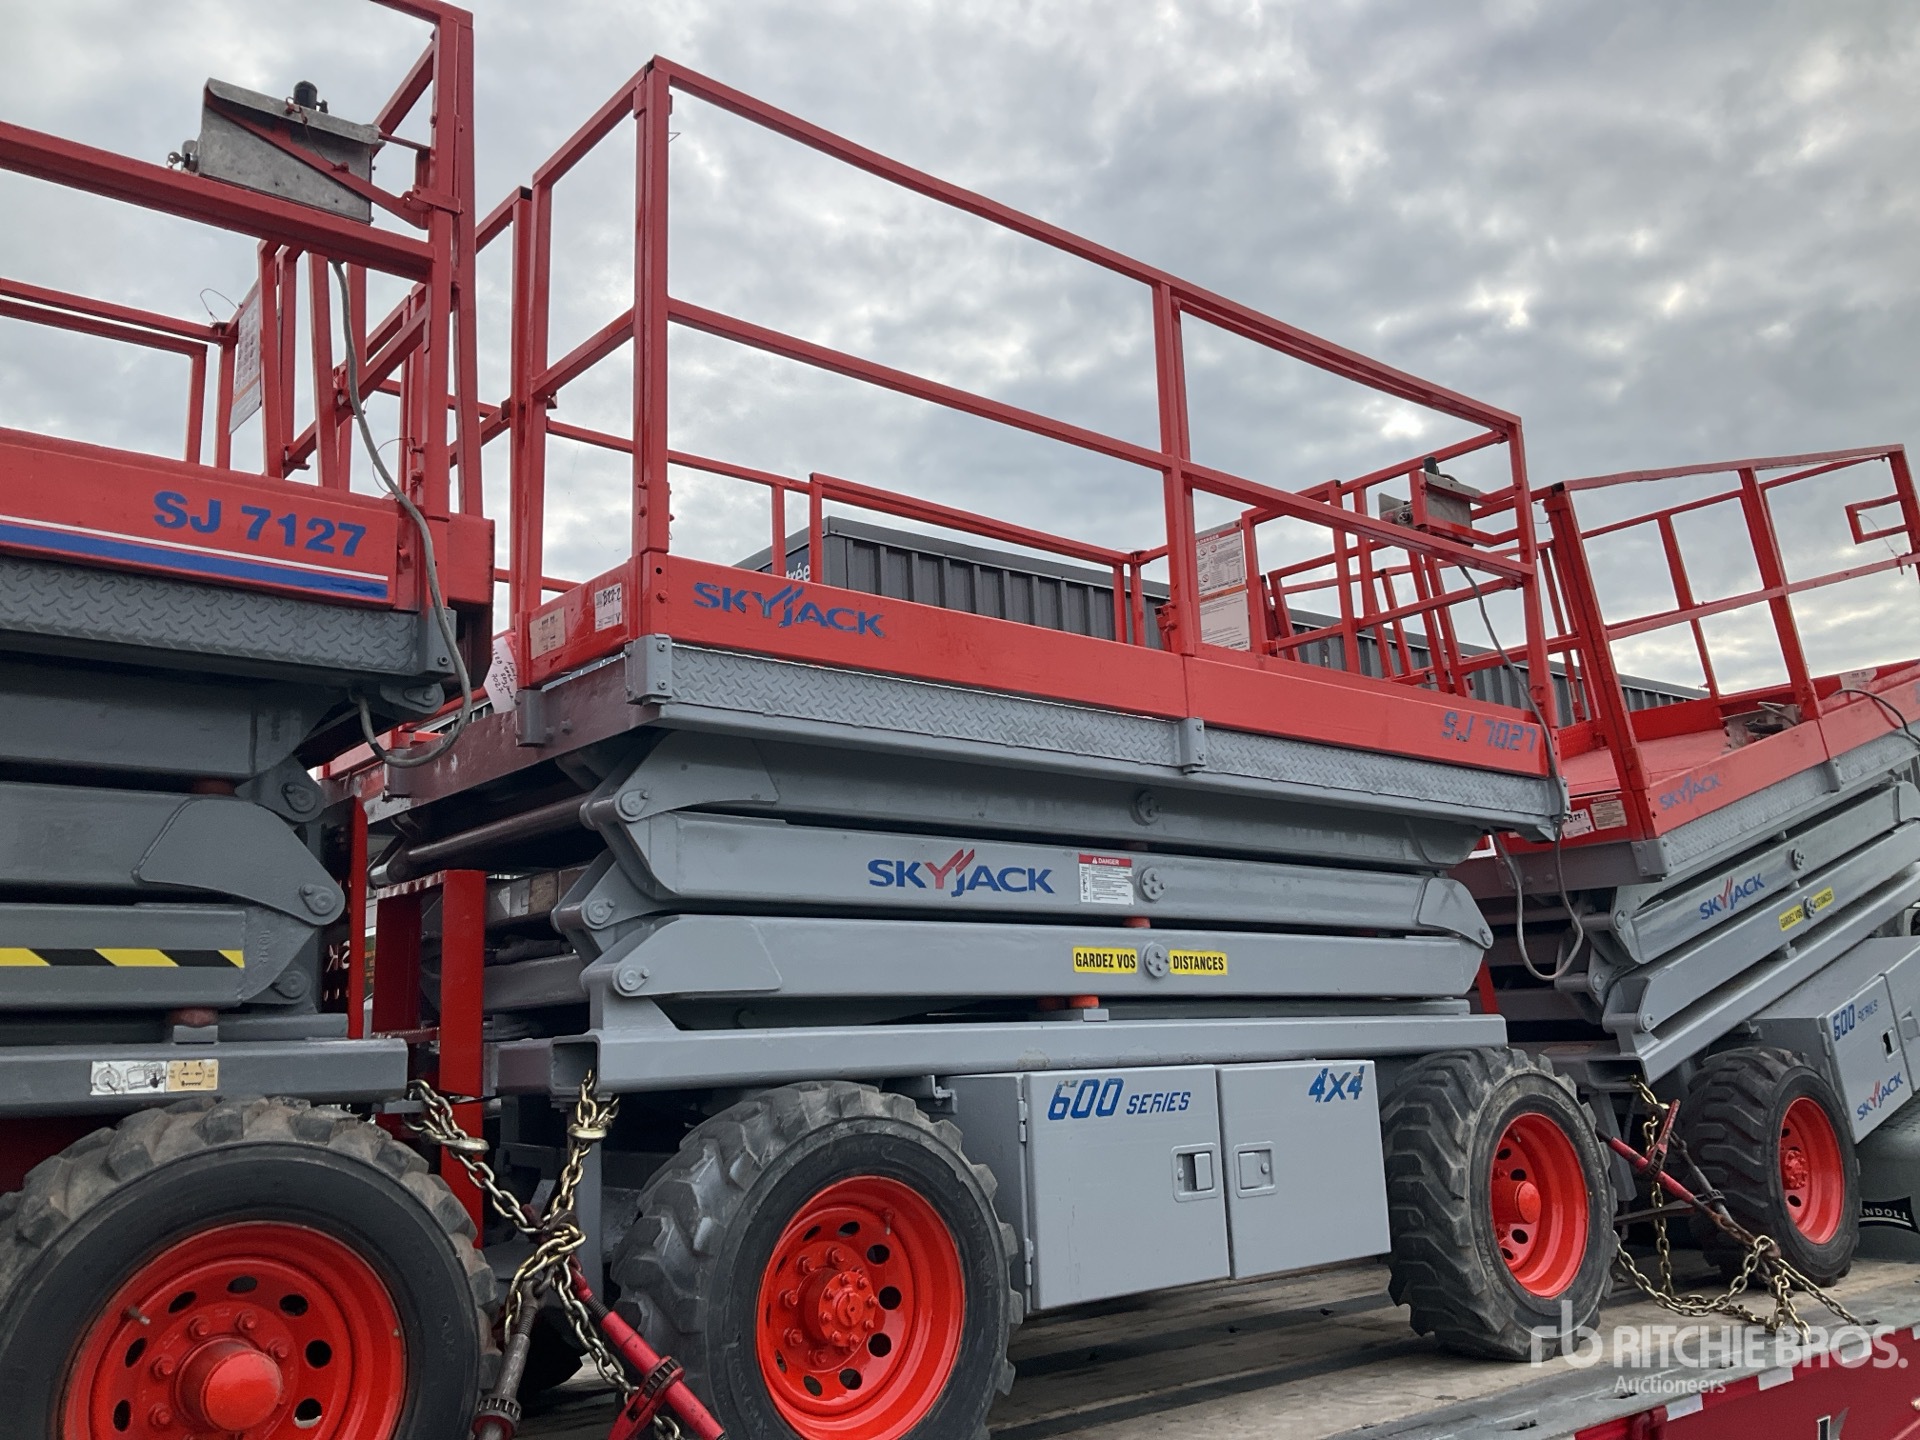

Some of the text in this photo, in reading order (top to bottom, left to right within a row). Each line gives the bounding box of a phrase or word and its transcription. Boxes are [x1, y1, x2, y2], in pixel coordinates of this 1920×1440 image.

[154, 490, 366, 557] SJ 7127
[693, 583, 885, 639] SKYJACK
[1441, 710, 1537, 753] SJ 7027
[1658, 773, 1722, 811] SKYJACK
[868, 848, 1056, 898] SKYJACK
[1098, 857, 1120, 866] DANGER
[1699, 873, 1766, 921] SKYJACK
[1075, 952, 1224, 971] GARDEZ VOS DISTANCES
[1833, 1004, 1855, 1041] 600
[1047, 1077, 1192, 1121] 600 SERIES
[1856, 1071, 1904, 1122] SKYJACK
[1863, 1207, 1910, 1221] NDOLL
